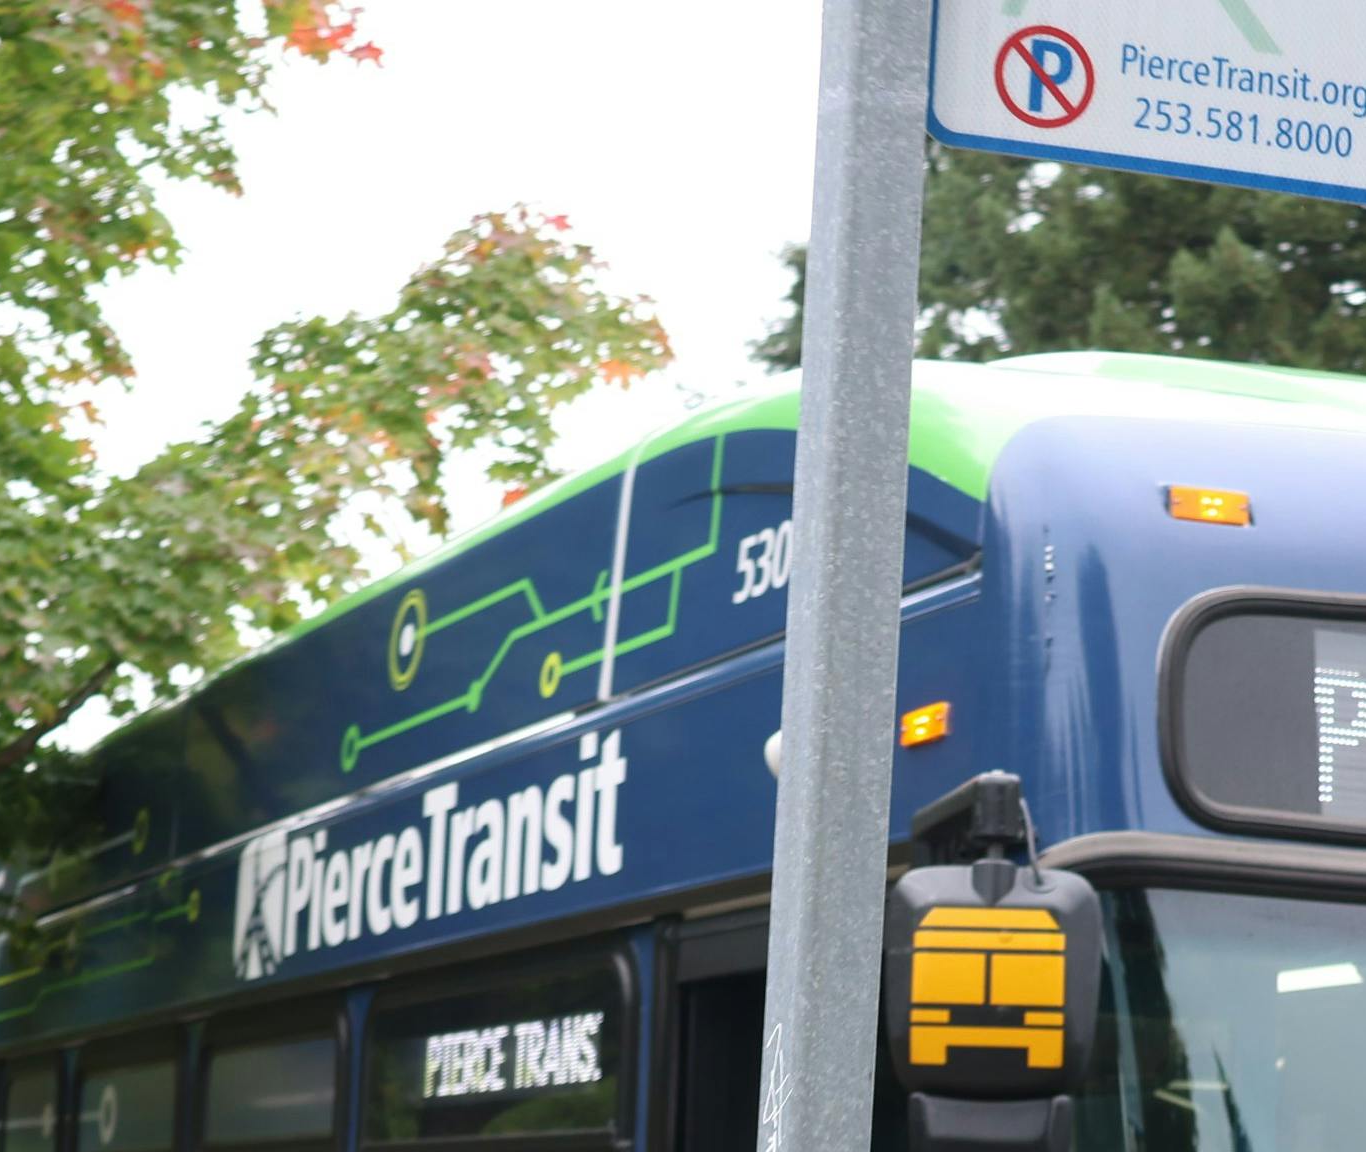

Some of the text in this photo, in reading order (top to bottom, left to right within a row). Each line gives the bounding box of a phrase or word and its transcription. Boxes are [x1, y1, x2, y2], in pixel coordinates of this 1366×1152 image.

[1133, 97, 1353, 158] 253.581.8000
[732, 519, 794, 605] 530
[282, 728, 628, 958] PierceTransit
[423, 1024, 510, 1099] PIERCE
